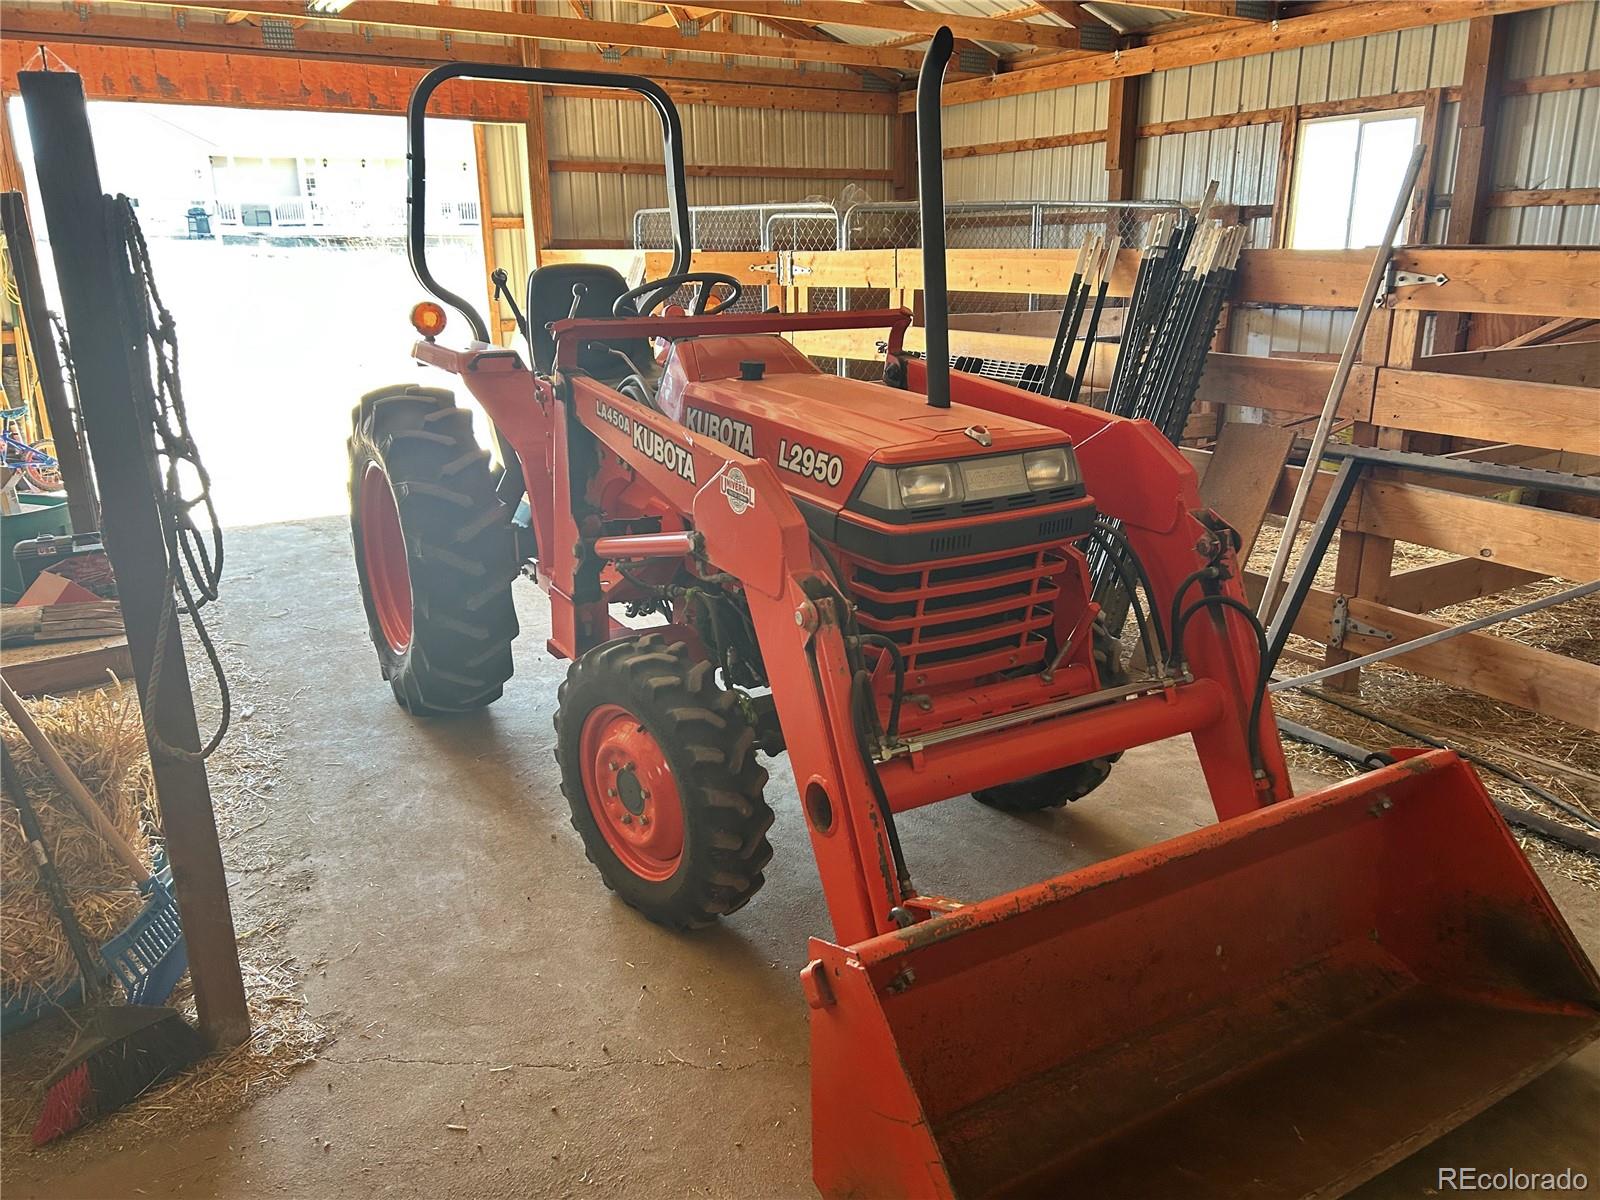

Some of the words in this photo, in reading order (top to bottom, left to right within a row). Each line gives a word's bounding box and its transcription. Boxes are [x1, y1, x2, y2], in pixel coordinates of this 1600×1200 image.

[596, 400, 631, 435] LA450A
[633, 422, 696, 486] KUBOTA
[685, 408, 755, 456] KUBOTA
[778, 439, 843, 487] L2950
